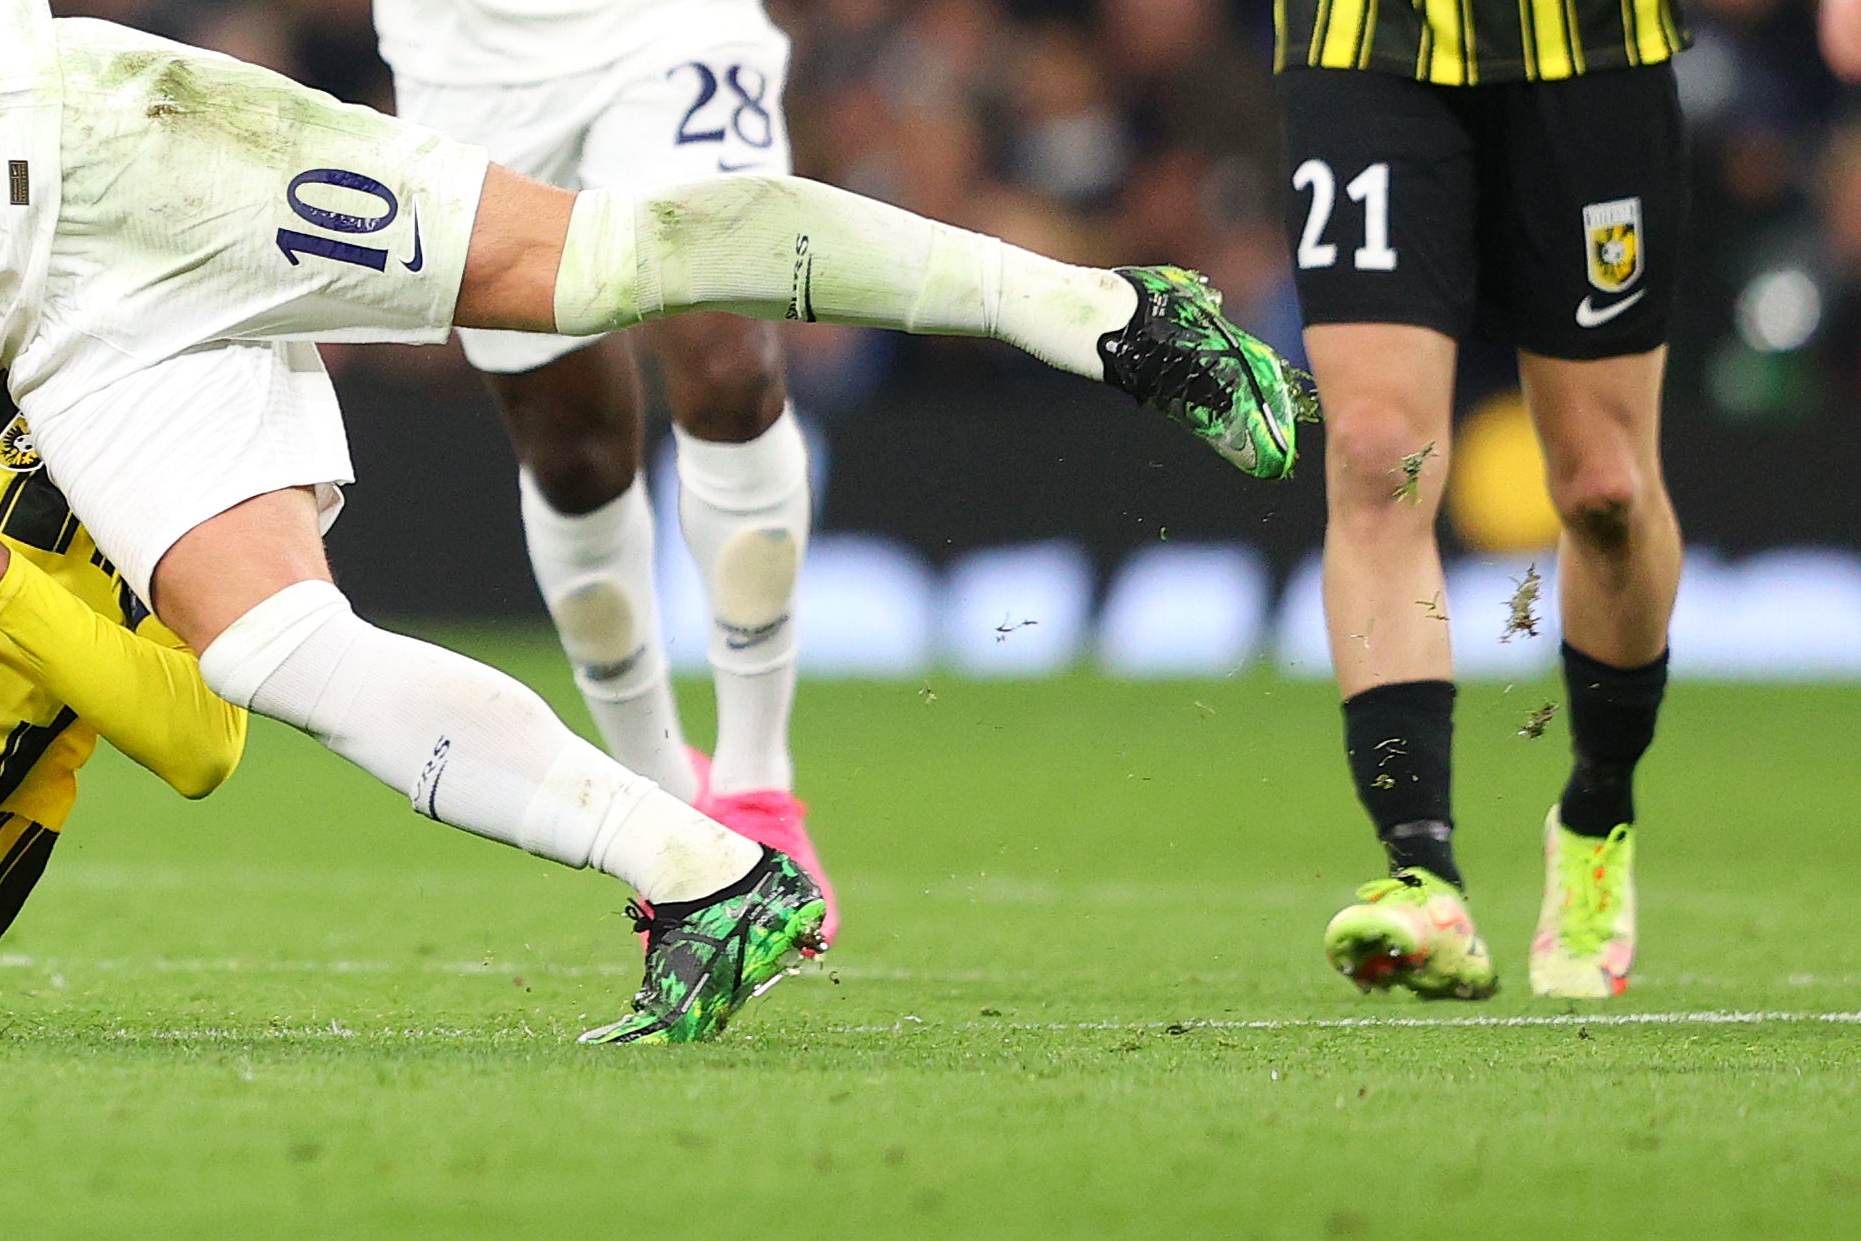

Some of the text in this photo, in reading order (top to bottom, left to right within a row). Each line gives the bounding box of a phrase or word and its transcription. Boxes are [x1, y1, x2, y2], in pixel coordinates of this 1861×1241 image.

[665, 60, 774, 149] 28
[275, 167, 399, 274] 10
[1291, 158, 1398, 272] 21
